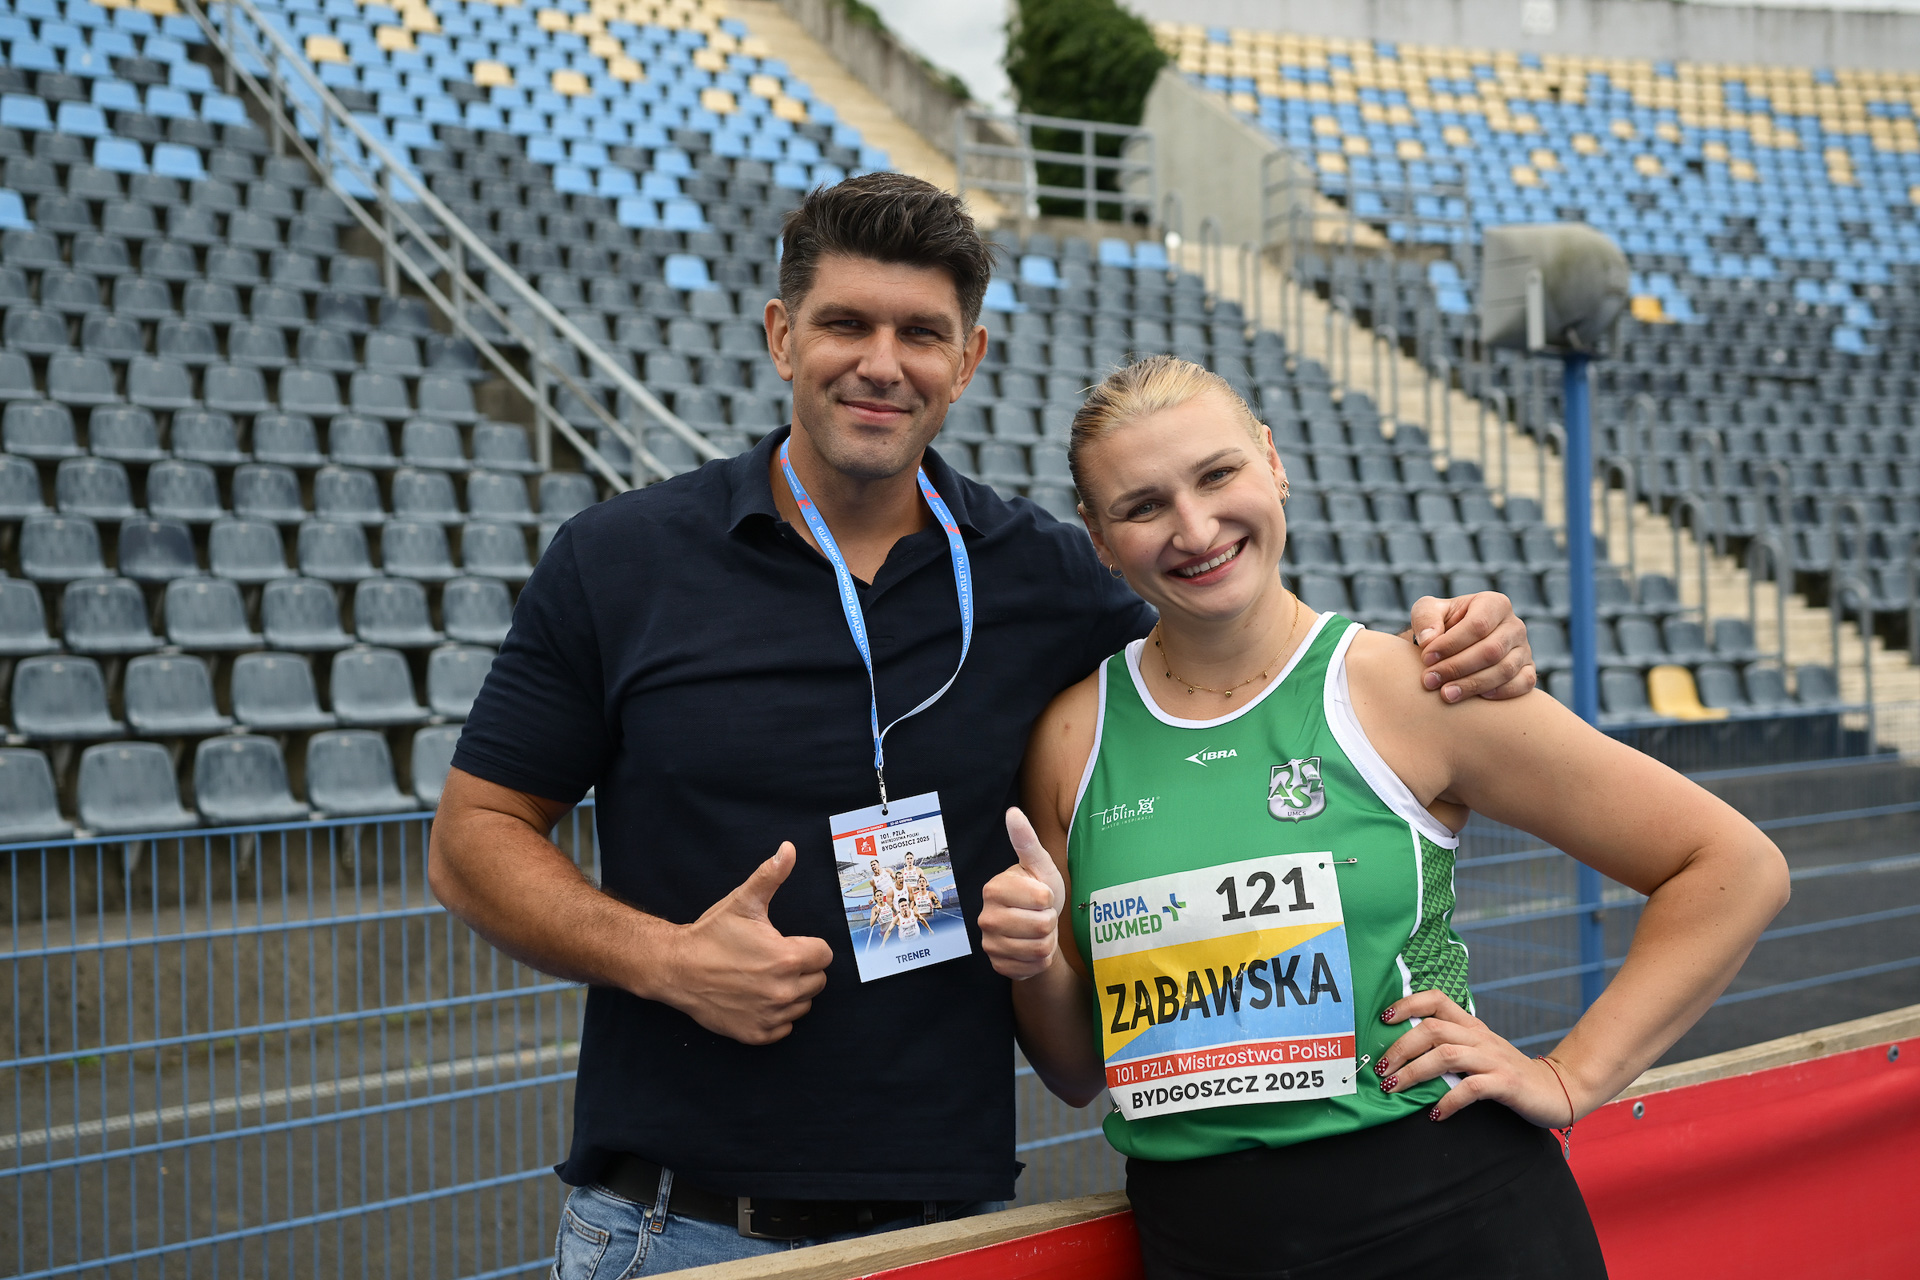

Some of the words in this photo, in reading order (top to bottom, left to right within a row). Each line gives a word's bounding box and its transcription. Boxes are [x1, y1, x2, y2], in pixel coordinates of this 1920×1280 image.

[816, 525, 855, 604] KUJAWSKO-POMORSKI
[849, 604, 864, 640] ZWIĄZEK
[957, 556, 968, 592] ATLETYKI
[881, 840, 916, 851] BYDGOSZCZ
[916, 835, 930, 844] 2025
[892, 829, 906, 837] PZLA
[1093, 896, 1149, 924] GRUPA
[1216, 866, 1314, 922] 121
[1094, 914, 1163, 944] LUXMED
[895, 948, 931, 964] TRENER
[1106, 952, 1342, 1034] ZABAWSKA
[1115, 1067, 1139, 1084] 101.
[1141, 1062, 1174, 1078] PZLA
[1177, 1046, 1283, 1073] Mistrzostwa
[1289, 1040, 1342, 1060] Polski
[1131, 1075, 1259, 1110] BYDGOSZCZ
[1265, 1070, 1325, 1091] 2025
